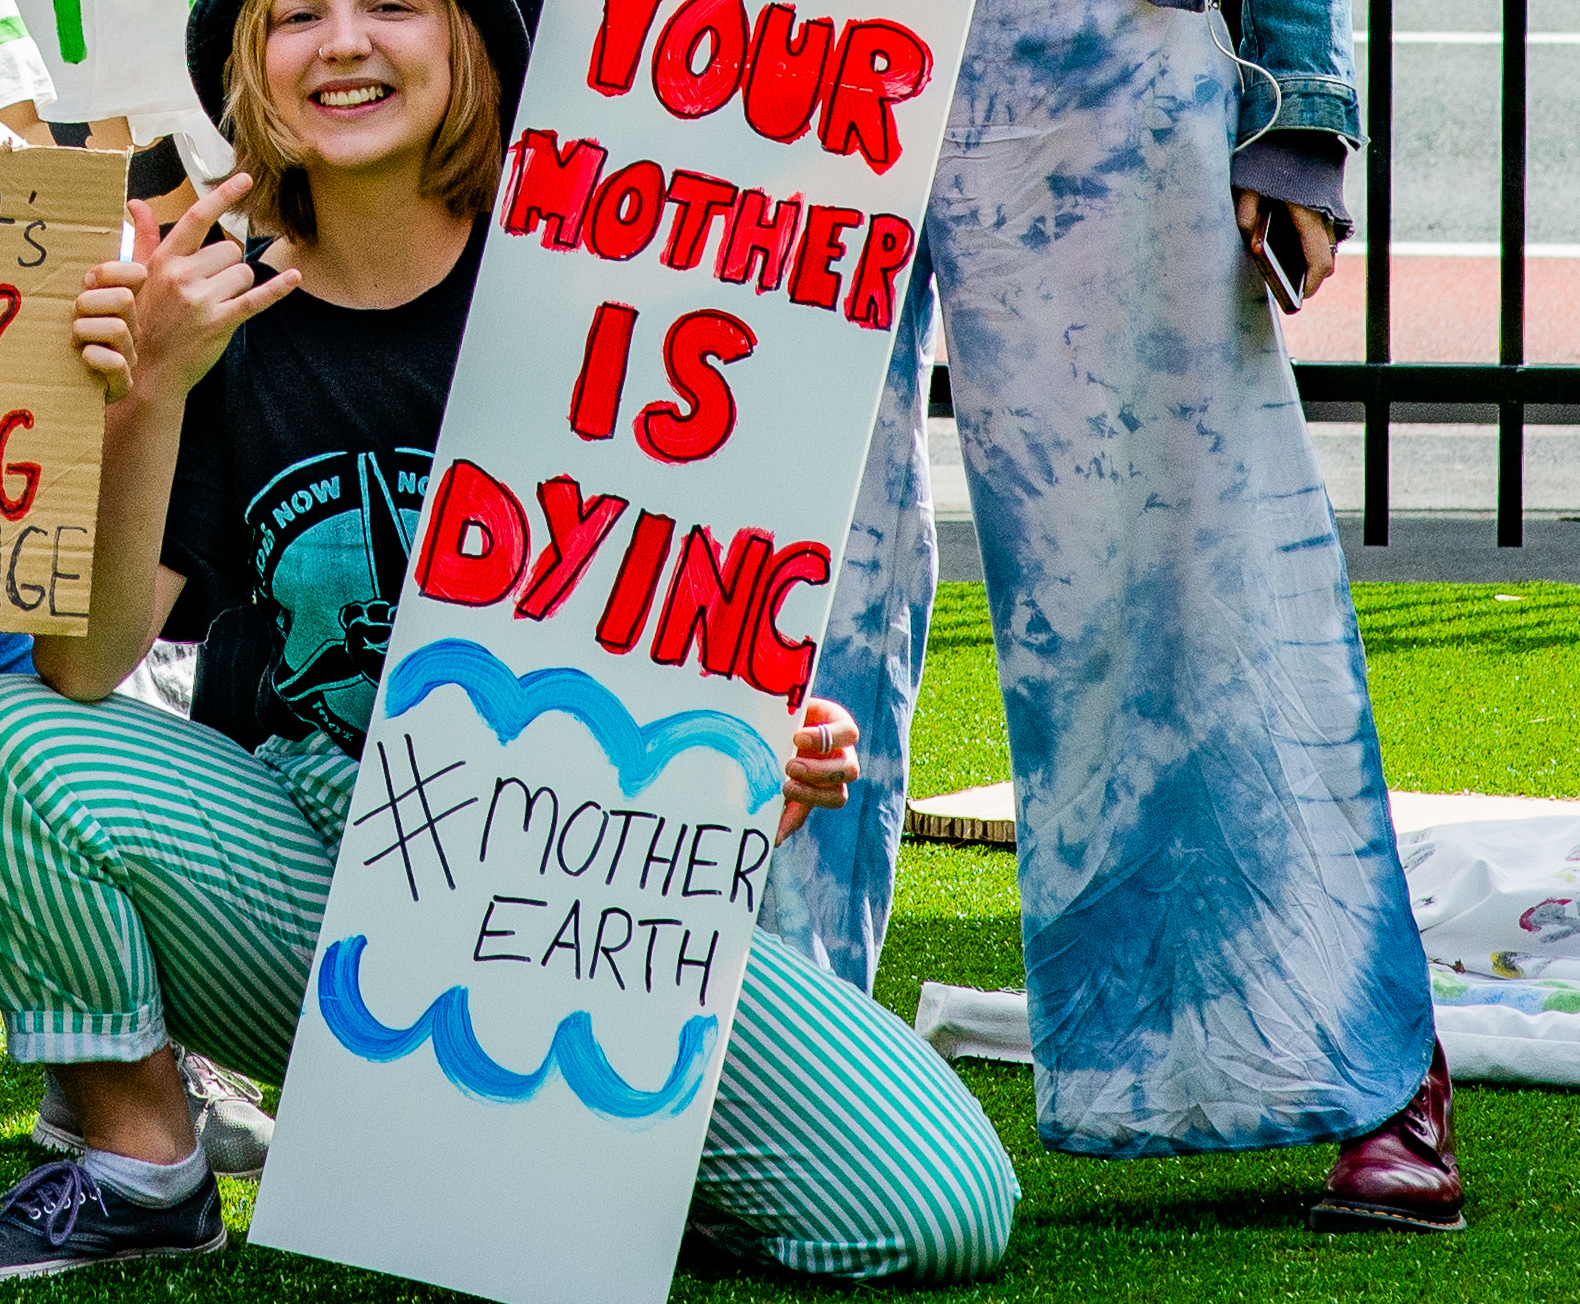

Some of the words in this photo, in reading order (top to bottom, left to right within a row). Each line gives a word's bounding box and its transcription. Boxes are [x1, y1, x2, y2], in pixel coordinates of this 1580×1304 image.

[501, 126, 916, 332] MOTHER
[567, 301, 757, 466] IS
[271, 475, 341, 530] NOW
[415, 458, 833, 716] DYING
[472, 895, 721, 1008] EARTH
